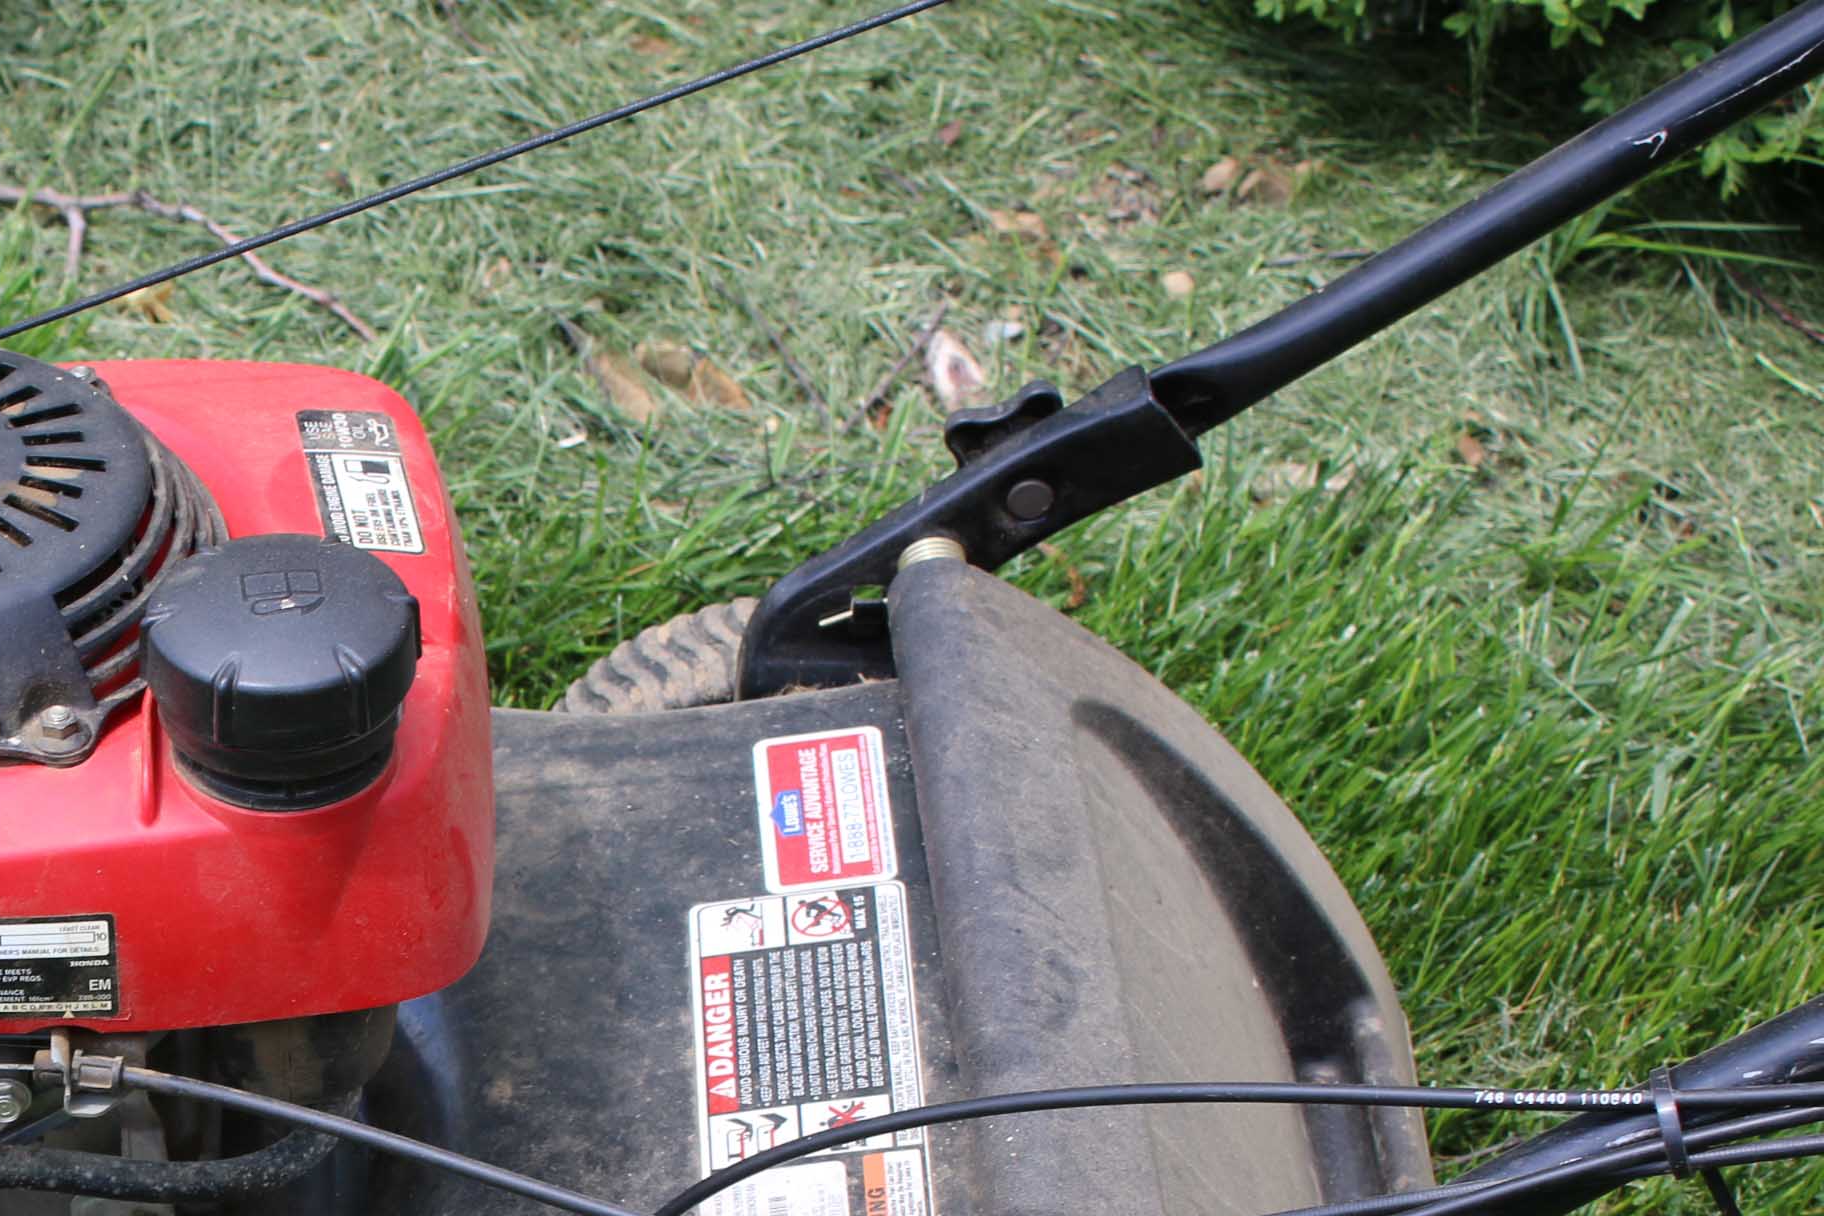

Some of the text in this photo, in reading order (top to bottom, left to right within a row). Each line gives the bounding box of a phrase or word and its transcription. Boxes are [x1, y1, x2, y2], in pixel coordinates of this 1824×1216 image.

[303, 420, 322, 439] USE
[350, 424, 366, 438] OIL
[314, 454, 334, 483] DAMAGE
[322, 485, 342, 510] ENGINE
[329, 512, 348, 533] AVOID
[350, 510, 373, 543] DO NOT
[797, 747, 829, 872] SERVICE ADVANTAGE
[853, 907, 866, 929] MAX
[96, 932, 107, 941] 10
[816, 945, 829, 963] MOW
[846, 942, 859, 970] BEHIND
[5, 968, 32, 976] MEETS
[817, 963, 830, 977] NOT
[848, 970, 861, 987] AND
[89, 979, 112, 991] EM
[753, 976, 766, 1004] ROTATING
[784, 977, 798, 1000] SAFETY
[818, 976, 831, 987] DO
[850, 987, 862, 1010] DOWN
[864, 985, 878, 1014] MOVING
[755, 1004, 767, 1021] FROM
[786, 1000, 799, 1020] WEAR
[831, 942, 853, 1090] SLOPES GREATER THAN MOW ACROSS NEVER
[702, 972, 735, 1077] DANGER
[732, 958, 752, 1104] AVOID SERIOUS INJURY OR DEATH
[756, 1022, 768, 1037] AWAY
[768, 951, 789, 1099] REMOVE OBJECTS THAT CAN BE THROWN BY THE
[821, 1016, 833, 1026] ON
[851, 1011, 864, 1033] LOOK
[867, 1014, 880, 1038] WHILE
[757, 1037, 769, 1052] FEET
[822, 1026, 835, 1056] CAUTION
[868, 1038, 881, 1055] AND
[758, 1052, 769, 1064] AND
[790, 1053, 801, 1067] ANY
[824, 1056, 838, 1079] EXTRA
[855, 1059, 868, 1076] AND
[758, 1064, 771, 1085] HANDS
[870, 1055, 884, 1086] BEFORE
[791, 1074, 804, 1096] BLADE
[826, 1078, 839, 1093] USE
[856, 1076, 868, 1088] UP
[760, 1085, 772, 1102] KEEP
[1474, 1090, 1504, 1104] 746
[1514, 1091, 1566, 1105] 04440
